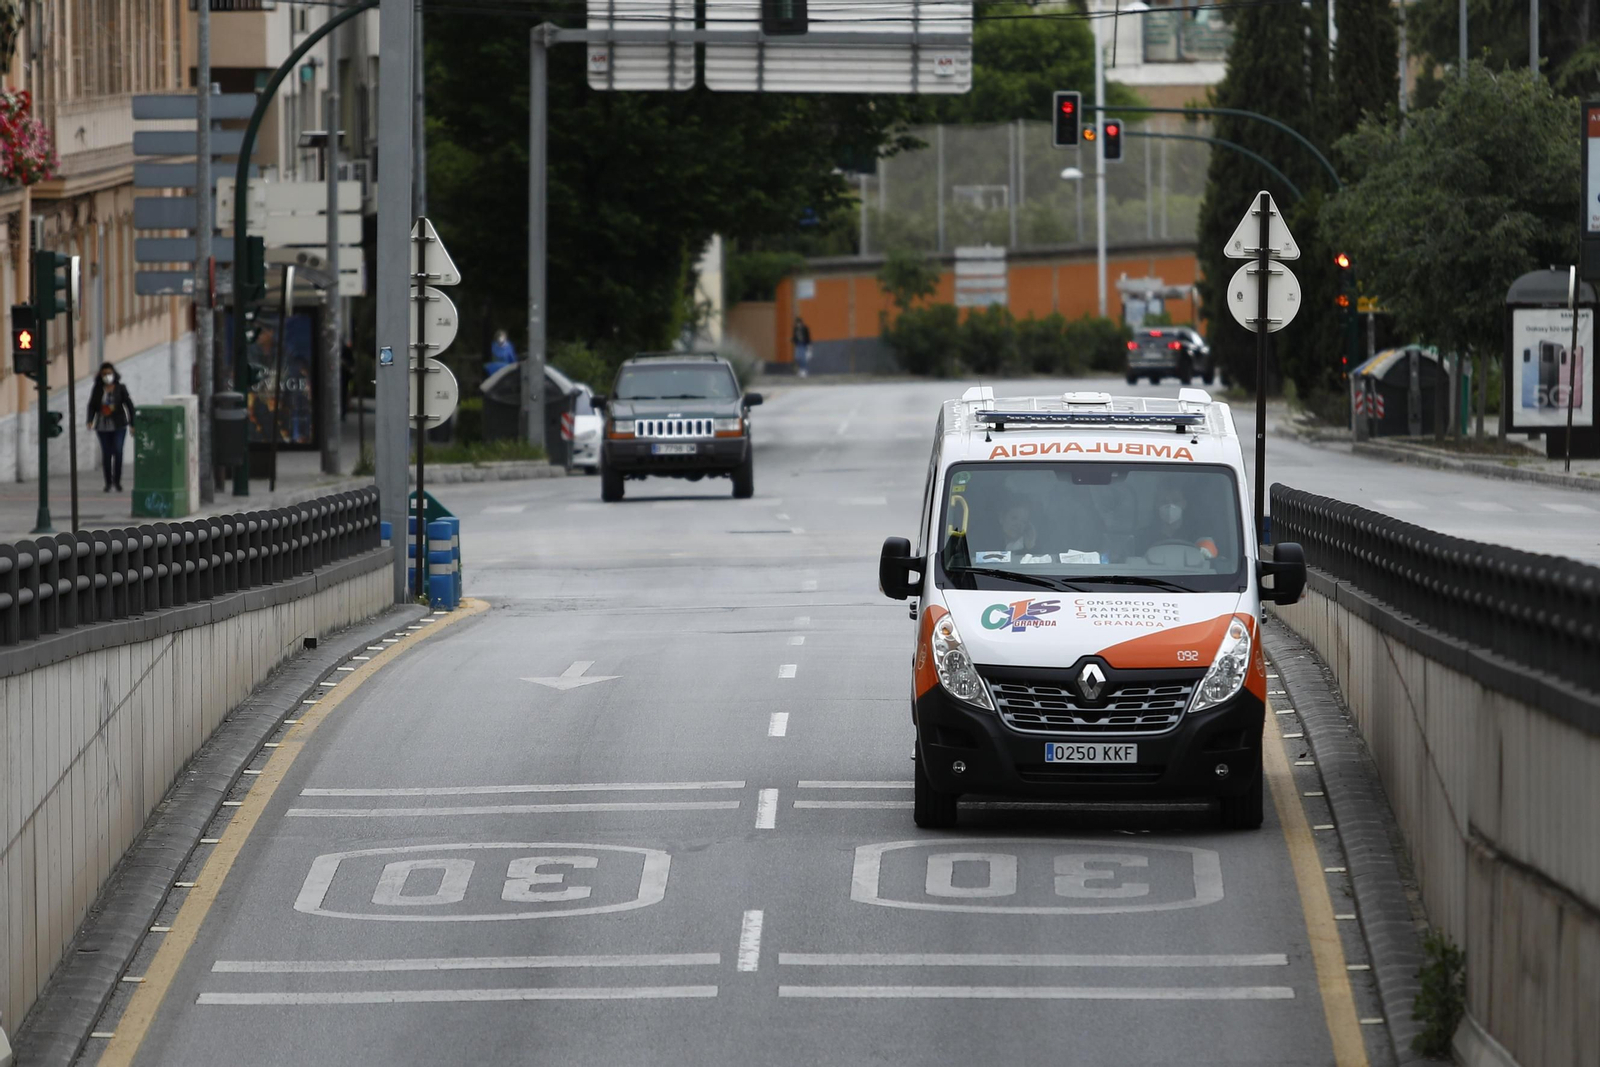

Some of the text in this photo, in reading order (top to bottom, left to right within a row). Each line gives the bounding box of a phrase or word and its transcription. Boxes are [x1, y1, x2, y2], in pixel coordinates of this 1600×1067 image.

[1074, 599, 1155, 607] CONSORCIO
[1075, 606, 1179, 615] TRANSPORTE
[1076, 612, 1156, 620] SANITARIO
[1014, 619, 1057, 628] GRANADA
[1093, 620, 1165, 628] GRANADA
[1177, 650, 1199, 662] 092
[1055, 745, 1097, 761] 0250
[1103, 746, 1135, 761] KKF
[925, 852, 1150, 898] 30
[371, 855, 599, 906] 30
